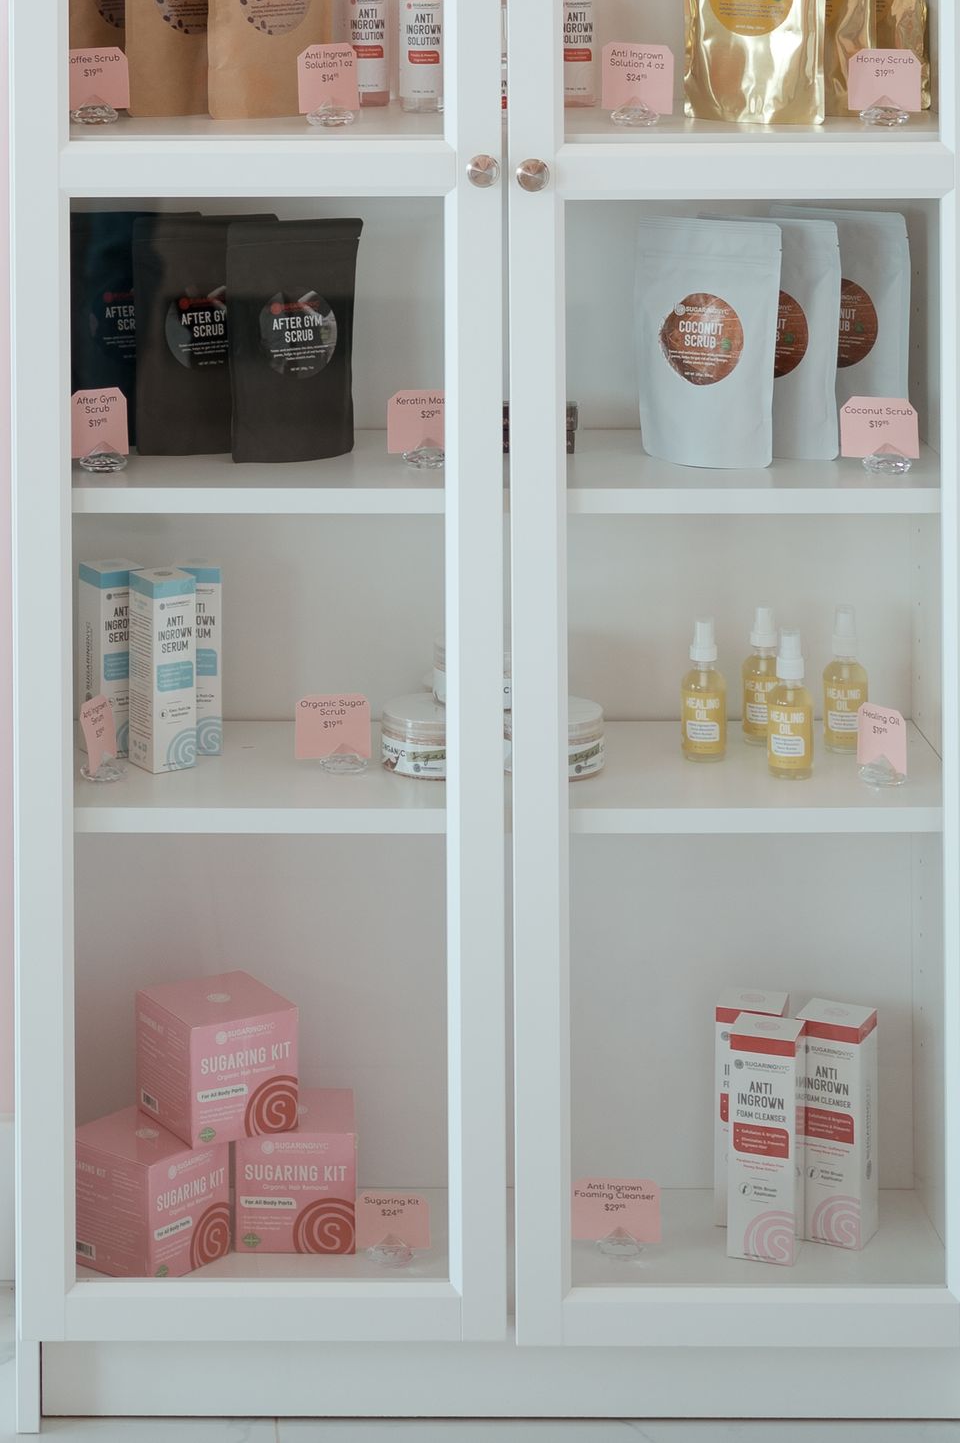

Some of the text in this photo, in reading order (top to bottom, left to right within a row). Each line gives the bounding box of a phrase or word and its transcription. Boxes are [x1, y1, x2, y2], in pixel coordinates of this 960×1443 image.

[359, 9, 377, 18] ANTI
[351, 20, 385, 29] INGROWN
[352, 32, 384, 40] SOLUTION
[95, 55, 120, 63] Scrub
[323, 50, 352, 59] Ingrown
[630, 51, 663, 60] Ingrown
[610, 59, 644, 68] Solution
[856, 56, 914, 65] Honey Scrub
[272, 315, 322, 331] AFTER GYM
[679, 320, 723, 335] COCONUT
[284, 330, 313, 342] SCRUB
[684, 335, 716, 348] SCRUB
[77, 396, 117, 404] After Gym
[85, 406, 110, 414] Scrub
[845, 407, 912, 416] Coconut Scrub
[167, 615, 184, 627] ANTI
[158, 627, 192, 641] INGROWN
[162, 640, 188, 653] SERUM
[301, 700, 365, 708] Organic Sugar
[686, 698, 720, 709] HEALING
[696, 710, 708, 721] OIL
[863, 709, 886, 725] Healing
[889, 716, 900, 726] Oil
[201, 1042, 291, 1075] SUGARING KIT
[750, 1081, 772, 1094] ANTI
[737, 1093, 784, 1110] INGROWN
[736, 1109, 786, 1123] FOAM CLEANSER
[245, 1164, 347, 1181] SUGARING KIT
[587, 1183, 642, 1193] Anti Ingrown
[575, 1191, 655, 1200] Foaming Cleanser
[364, 1196, 419, 1207] Sugaring Kit
